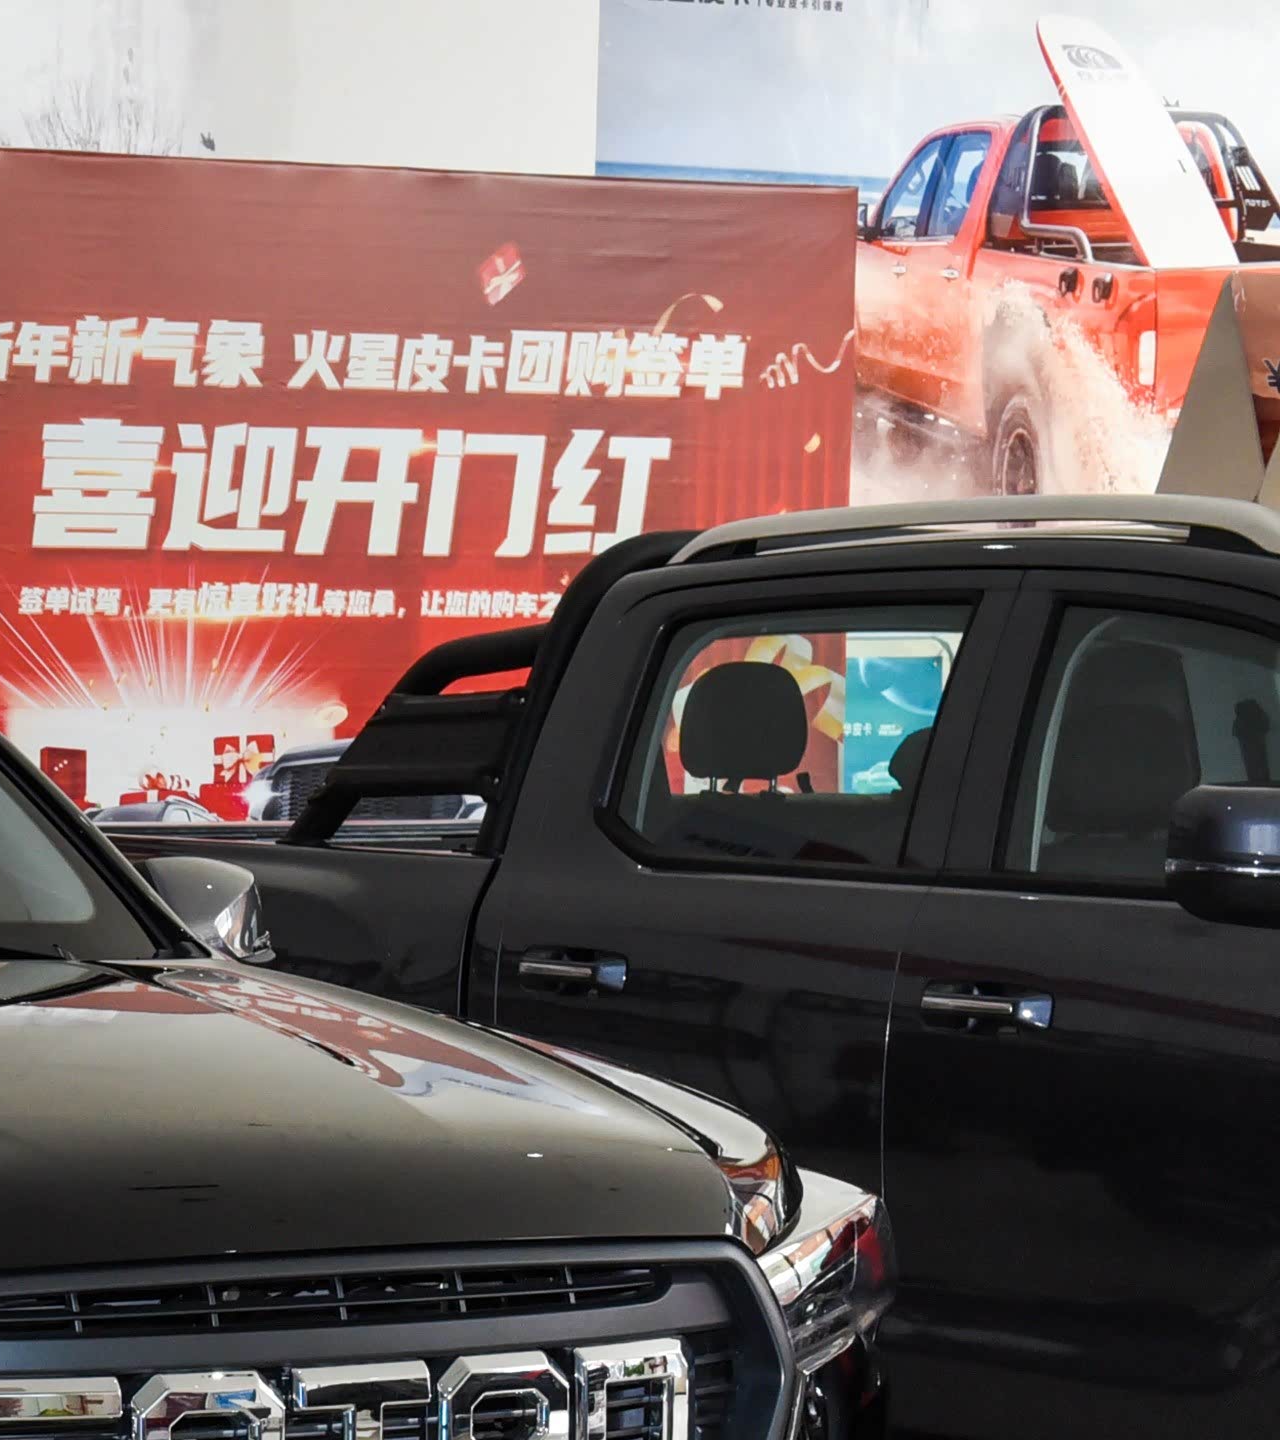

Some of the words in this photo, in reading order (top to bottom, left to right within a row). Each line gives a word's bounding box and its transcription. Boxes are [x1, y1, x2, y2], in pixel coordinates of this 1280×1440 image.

[287, 329, 748, 400] 火星皮卡团购签单
[31, 417, 672, 557] 喜迎开门红
